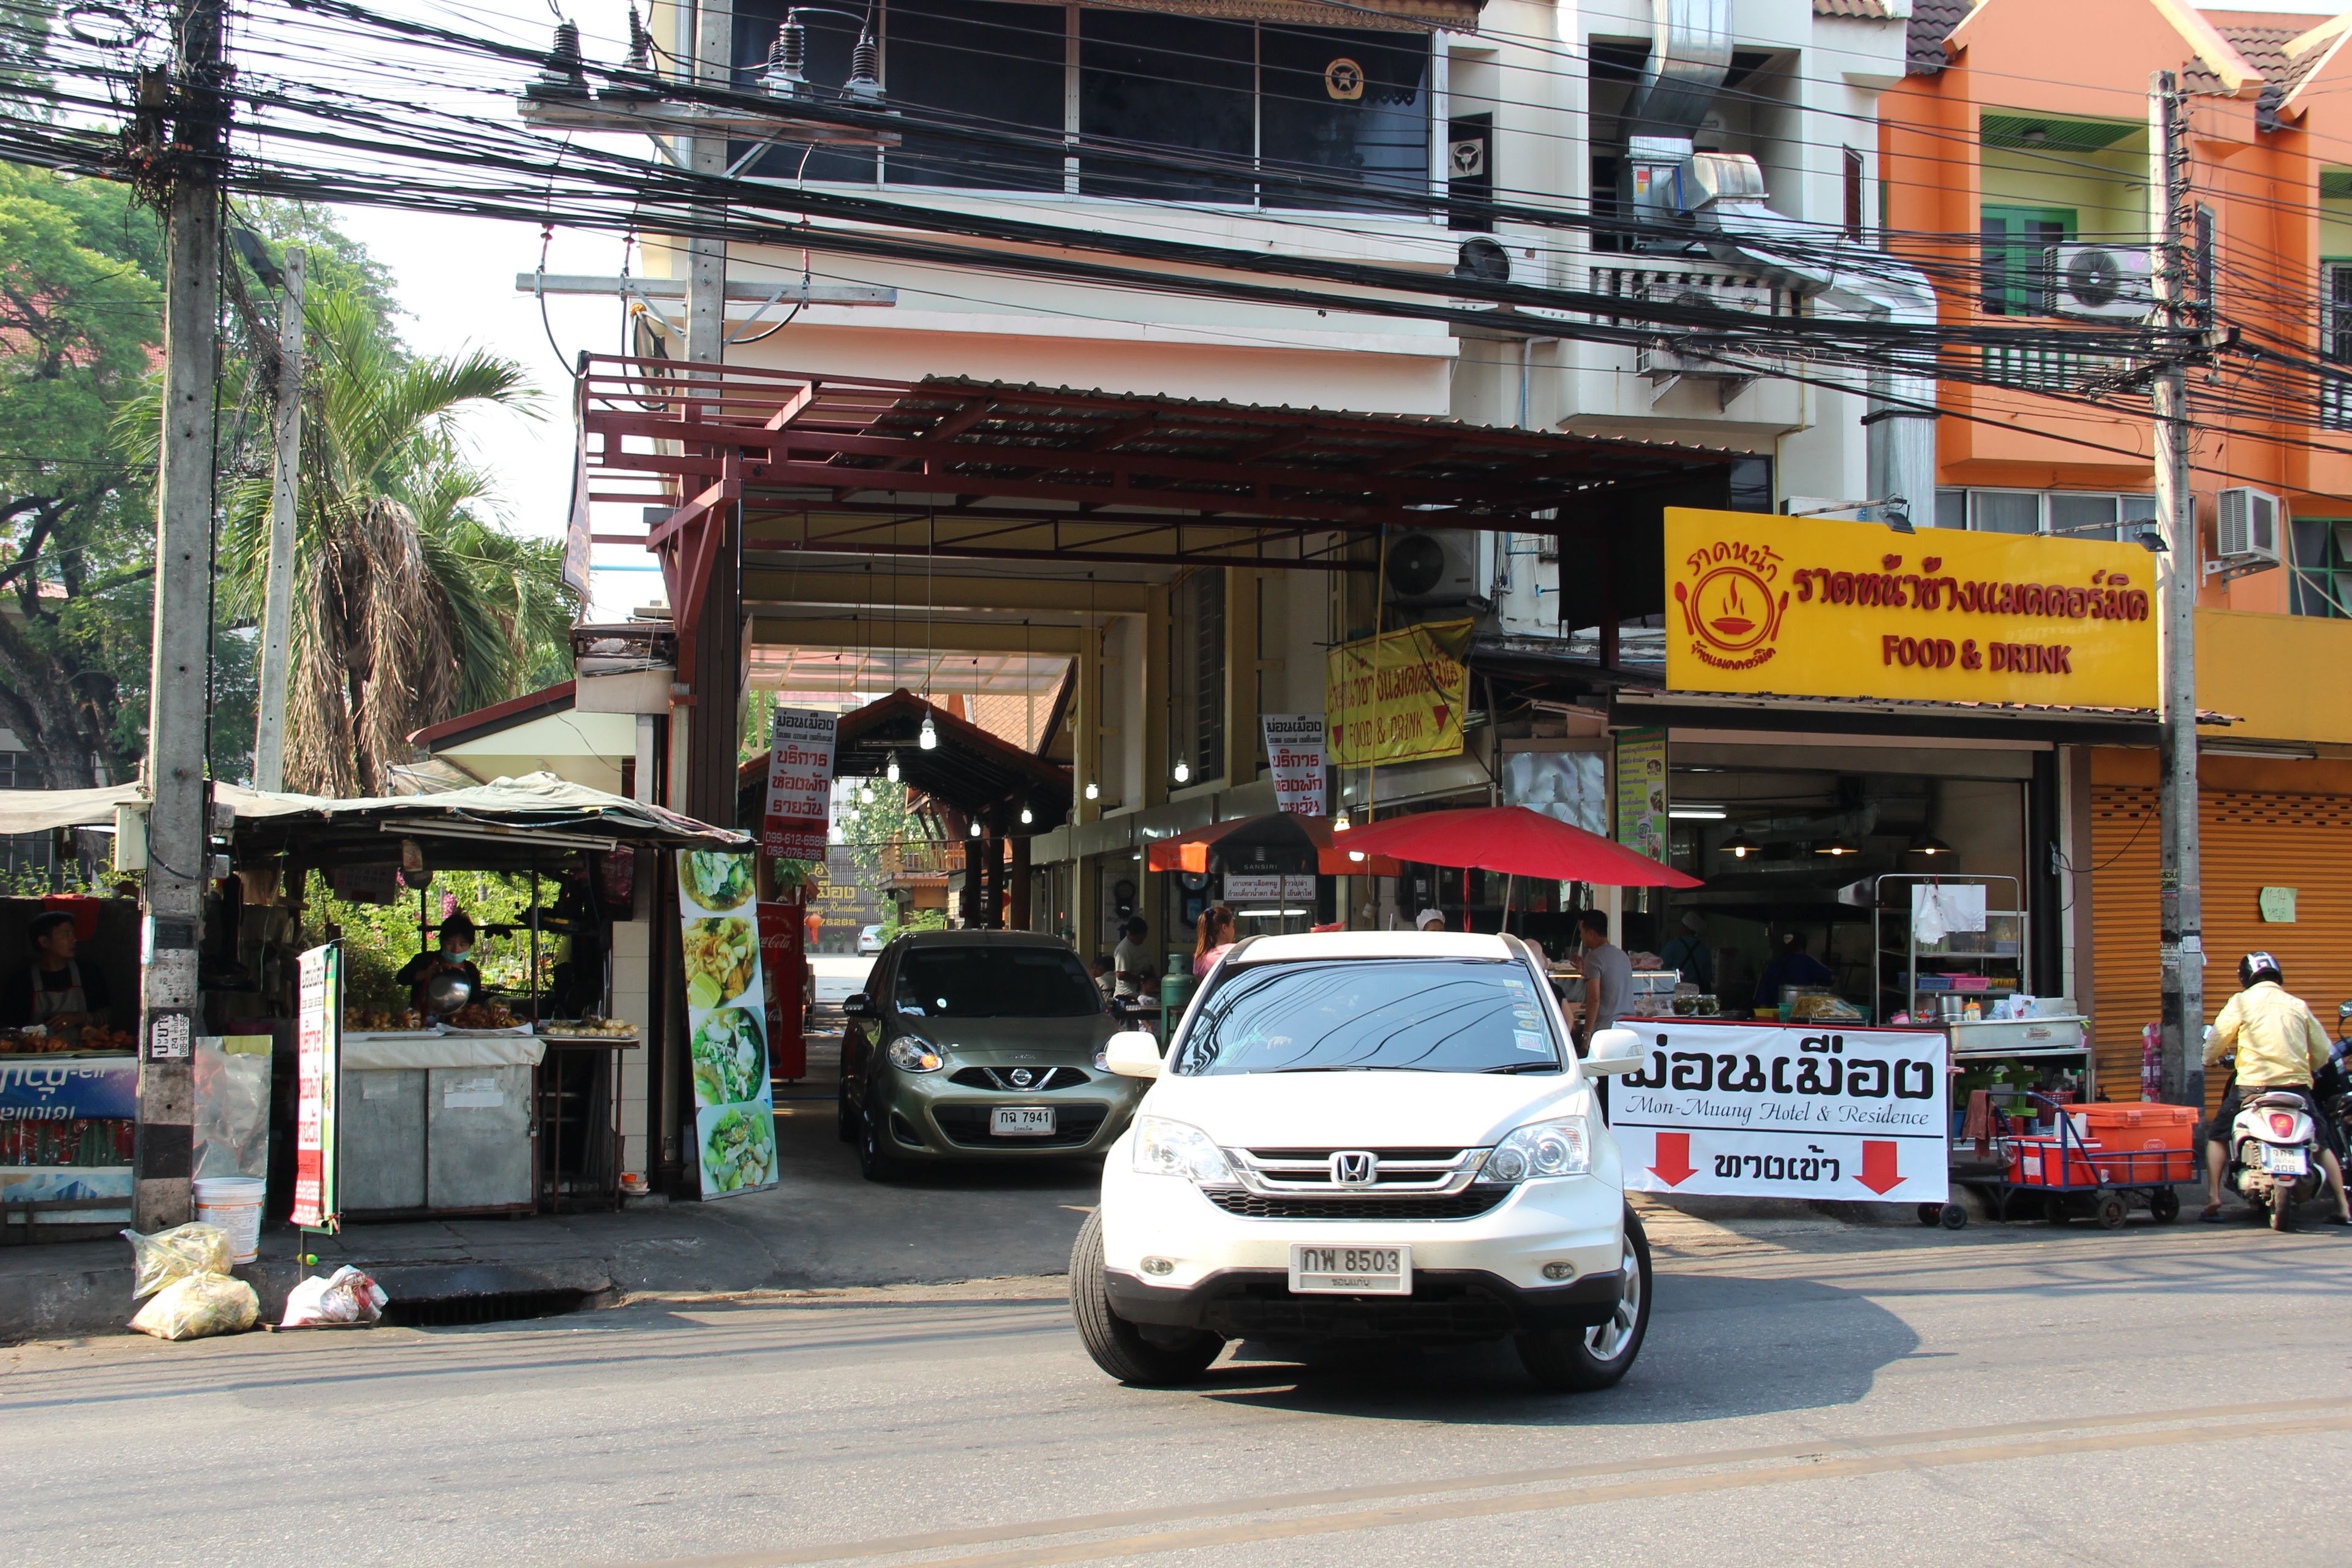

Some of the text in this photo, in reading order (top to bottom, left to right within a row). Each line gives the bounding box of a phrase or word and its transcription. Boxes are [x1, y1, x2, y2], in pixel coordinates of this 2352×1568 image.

[1882, 635, 2072, 674] FOOD & DRINK
[777, 711, 834, 731] ม่อนเมือง
[1267, 715, 1322, 733] ม่อนเมือง
[1349, 711, 1423, 748] FOOD & DRINK
[777, 745, 827, 767] บริการ
[1272, 748, 1319, 767] บริการ
[772, 769, 829, 792] ห้องพัก
[1274, 773, 1322, 792] ห้องพัก
[772, 796, 823, 816] รายวัน
[765, 832, 826, 847] 099-612-6586
[767, 845, 822, 860] 052-076-286
[1023, 1112, 1048, 1123] 7941
[1625, 1095, 1930, 1126] Mon-Muang Hotel & Residence
[1715, 1145, 1840, 1181] ทางเข้า
[1345, 1250, 1398, 1272] 8503
